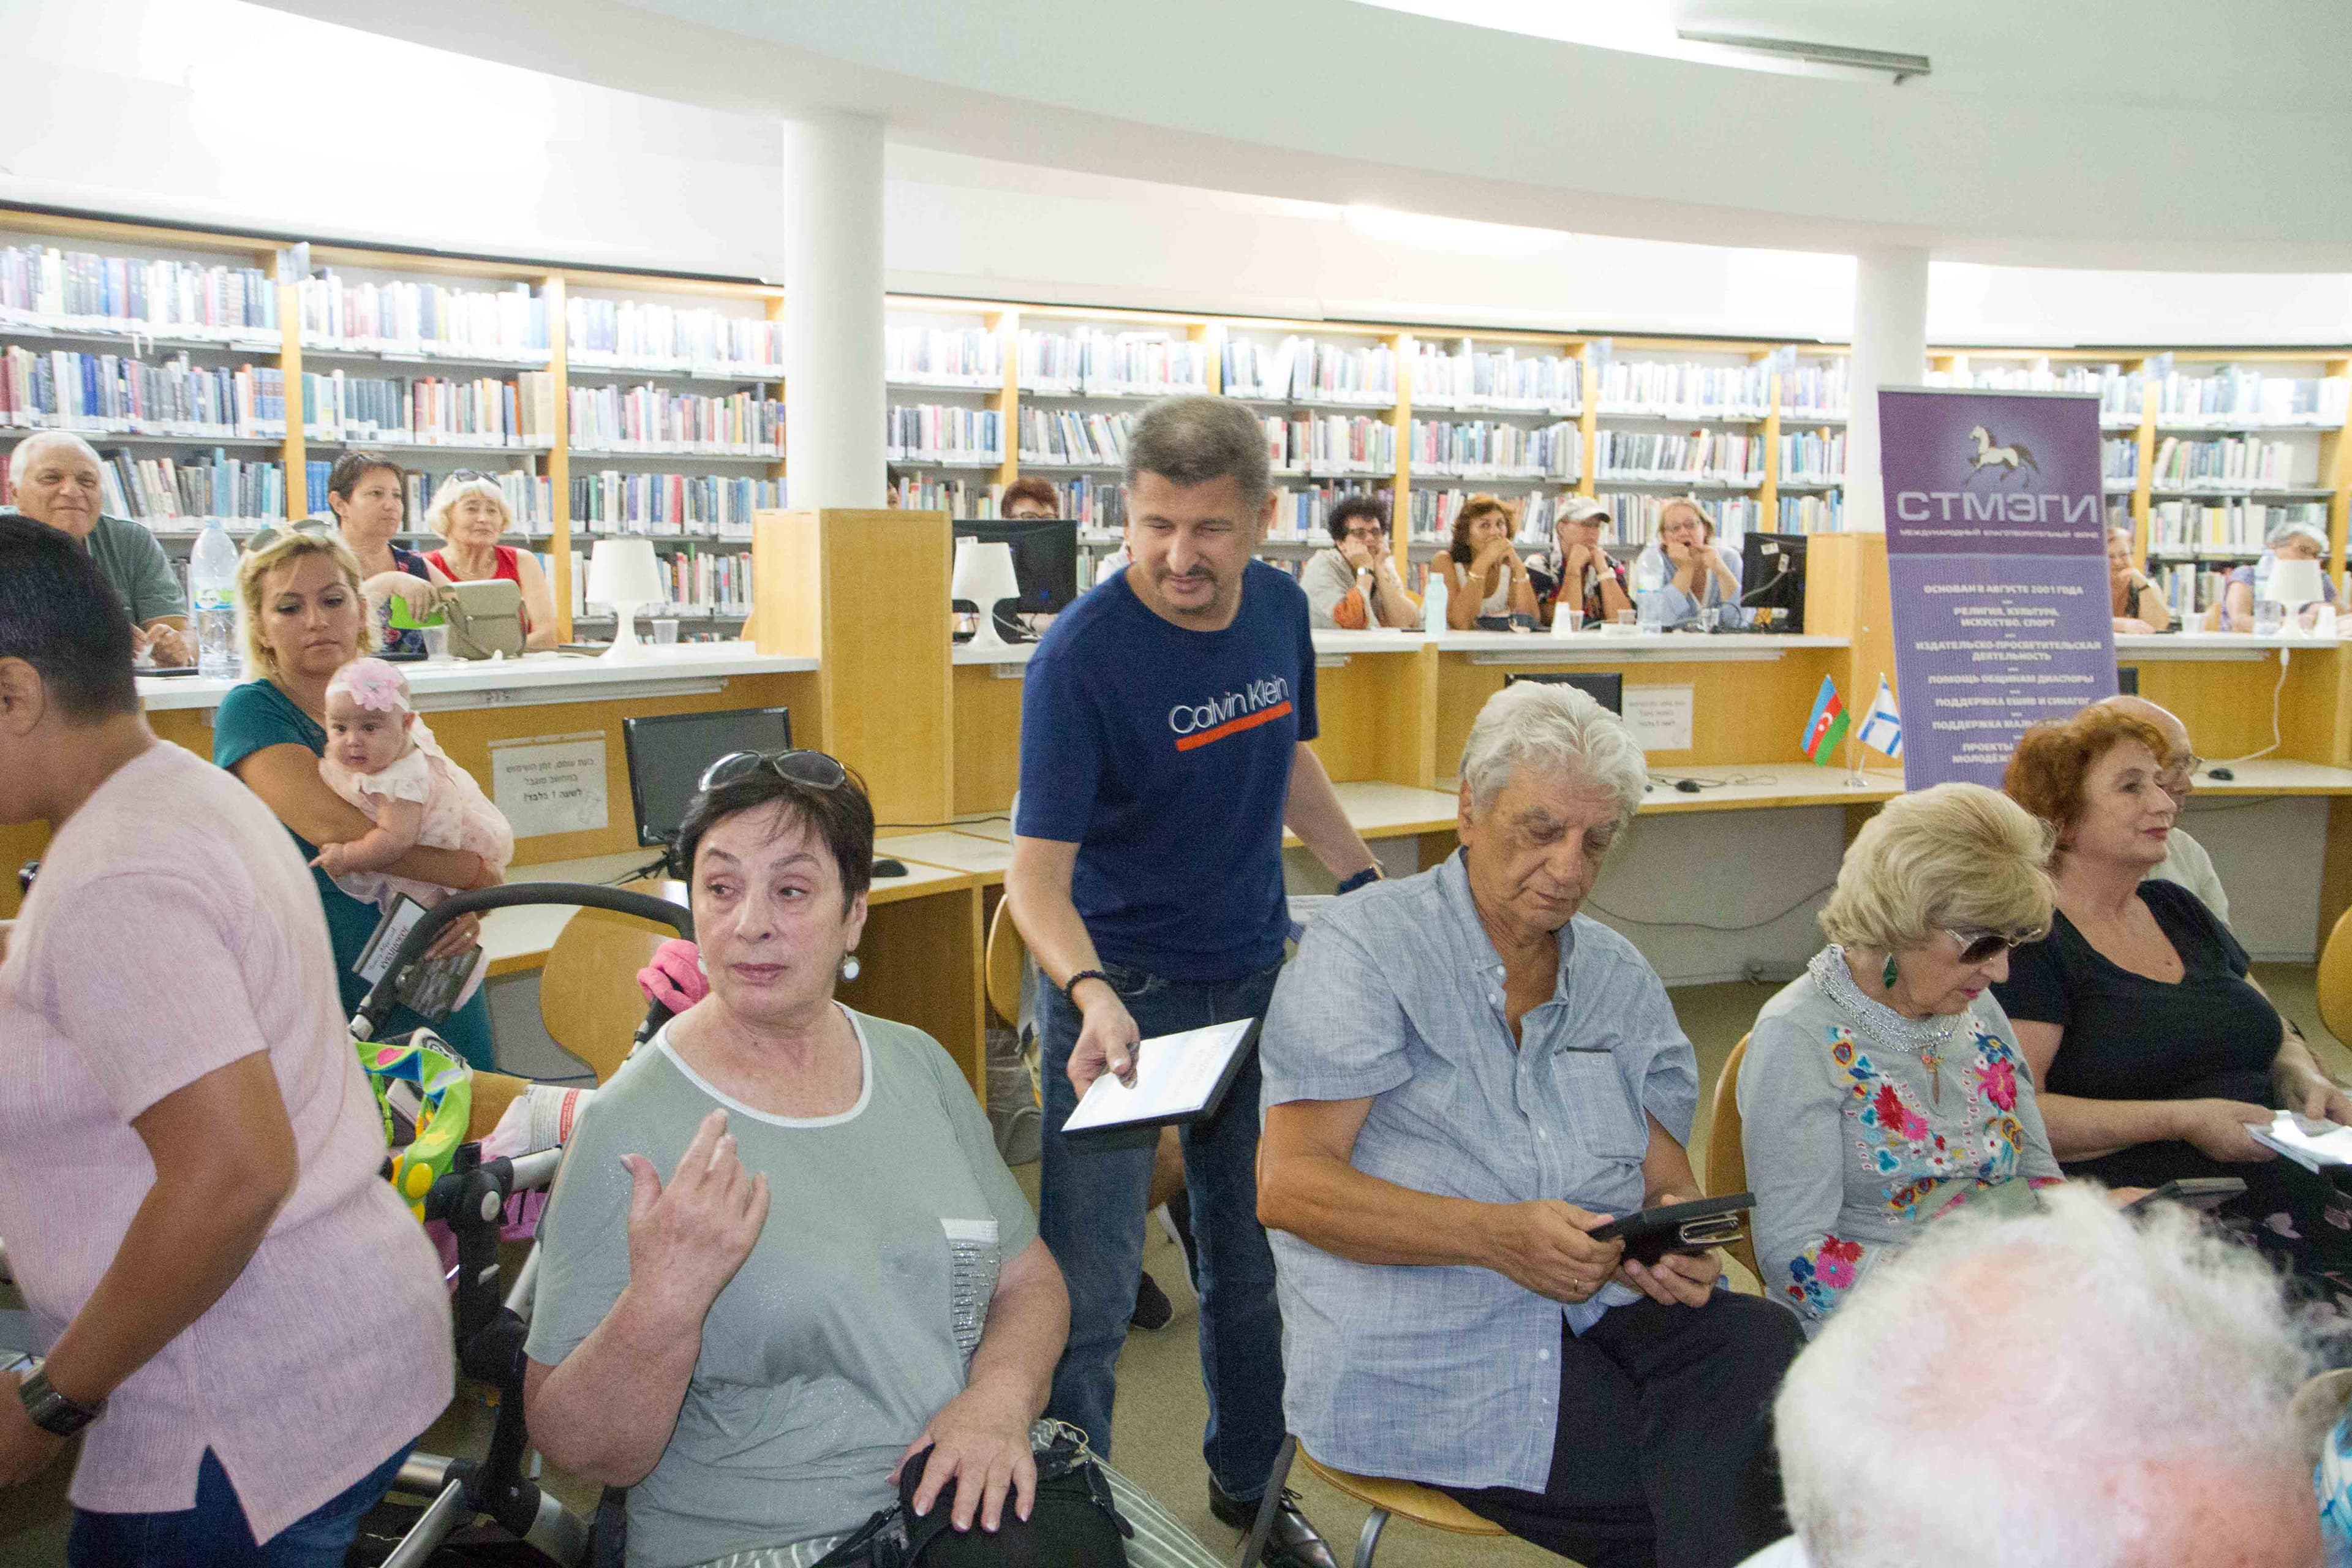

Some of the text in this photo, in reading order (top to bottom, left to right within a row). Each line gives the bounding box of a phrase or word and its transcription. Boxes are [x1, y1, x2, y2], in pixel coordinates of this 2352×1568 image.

[1897, 491, 2098, 523] СТМЭГИ
[1924, 584, 1976, 594] ОСНОВАН
[1986, 585, 2029, 594] АВГУСТЕ
[2030, 586, 2055, 594] 2001
[2056, 586, 2084, 595] ГОДА
[2023, 619, 2056, 627] СПОРТ
[1972, 652, 2052, 661] ДЕЯТЕЛЬНОСТЬ
[1928, 674, 2094, 685] ПОМОЩЬ ОБЩИНАМ ДИАСПОРЫ
[1168, 674, 1289, 734] Calvin Klein
[1936, 697, 2005, 707] ПОДДЕРЖКА
[1932, 720, 2003, 730] ПОДДЕРЖКА
[1963, 742, 2013, 752] ПРОЕКТЫ
